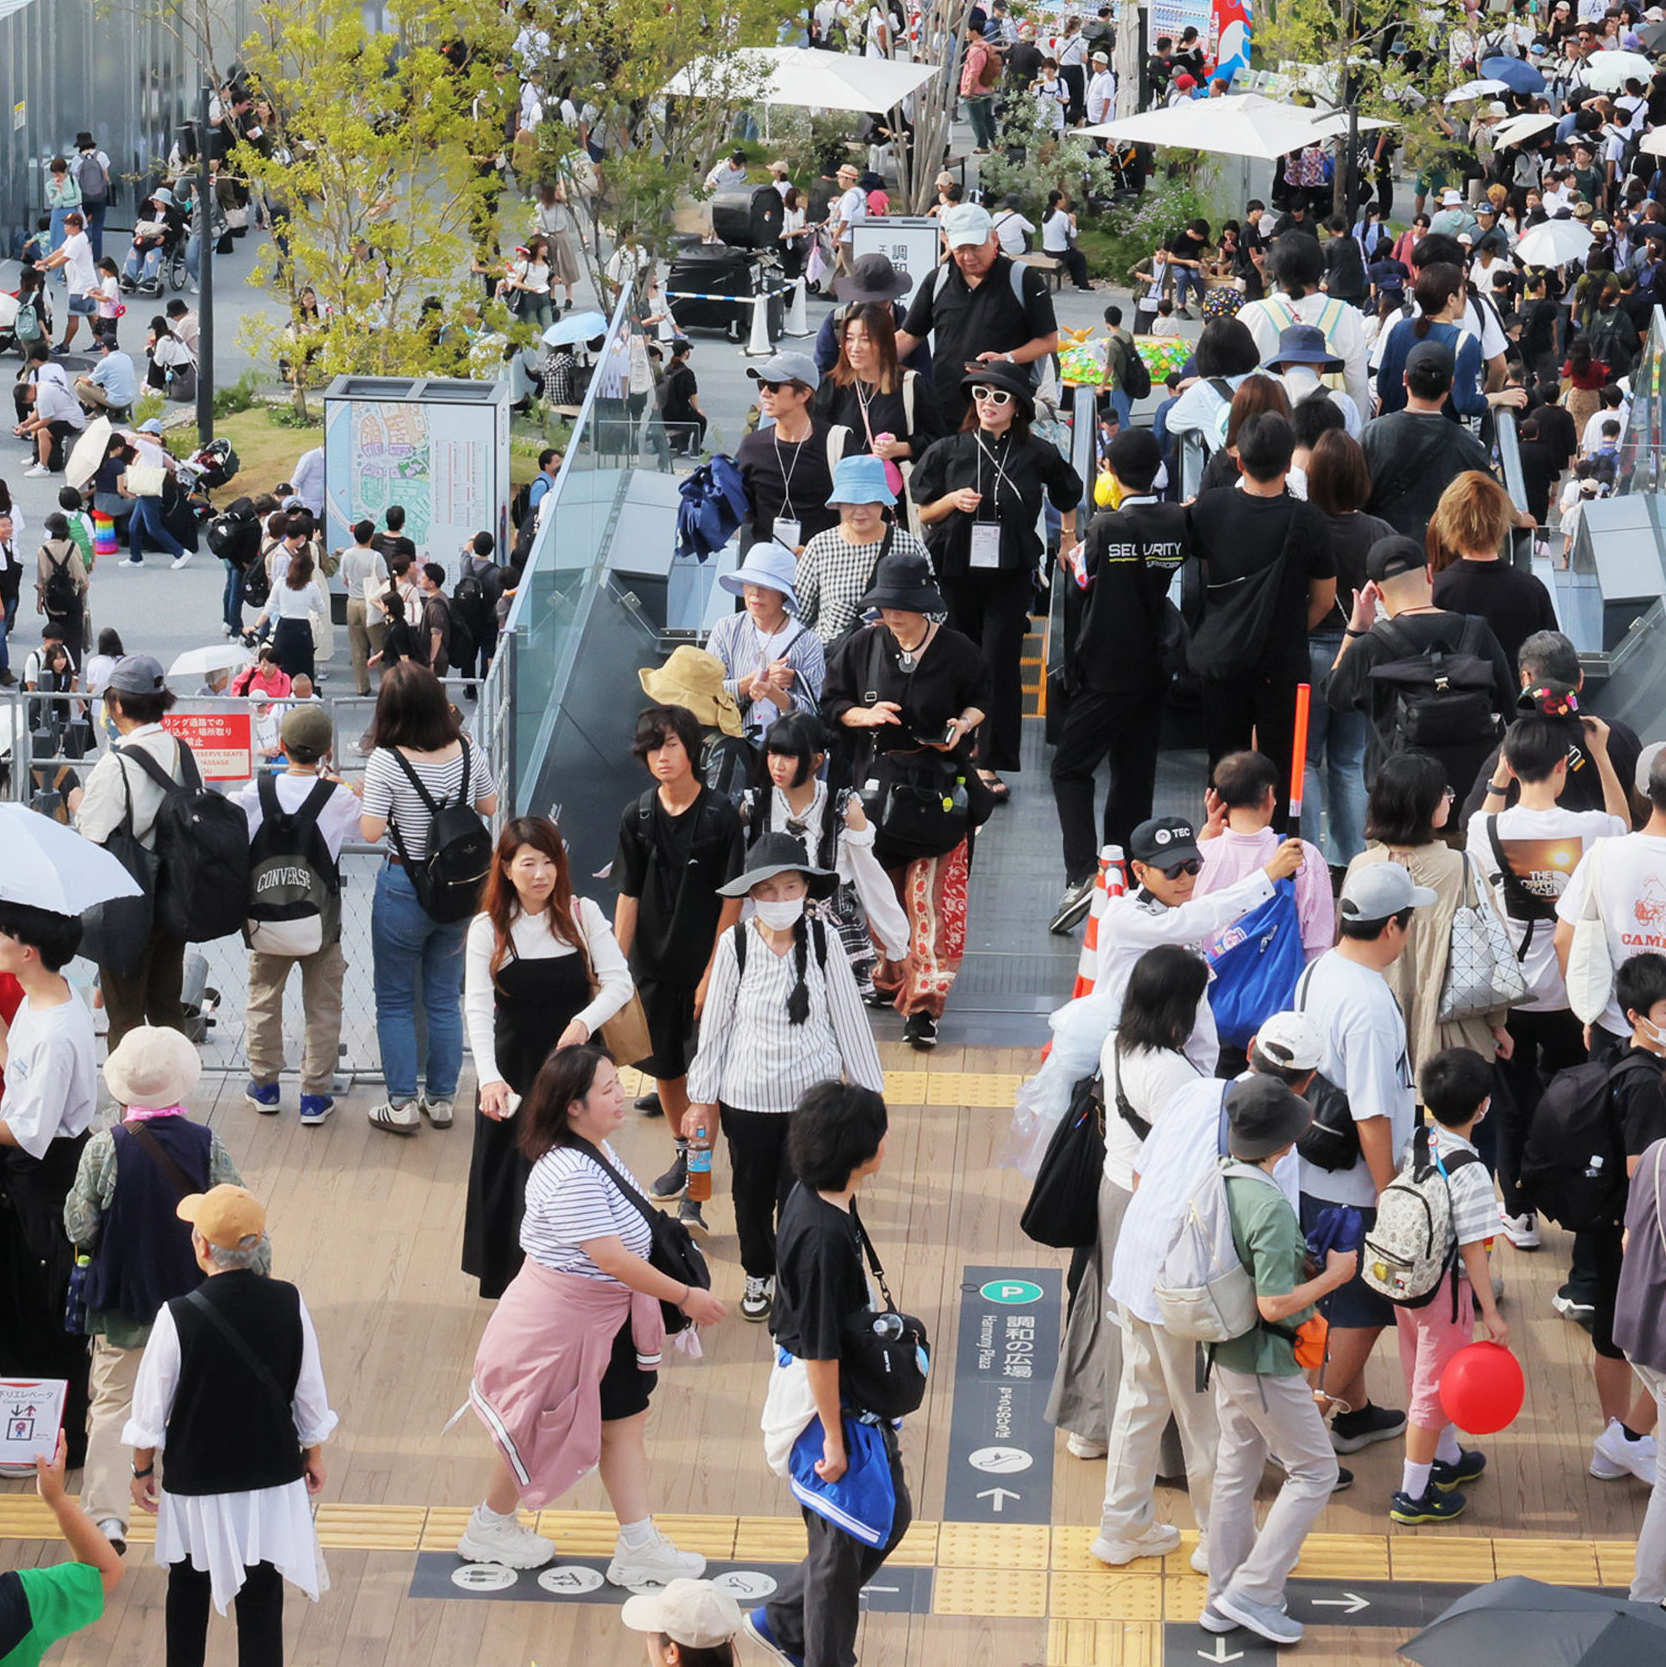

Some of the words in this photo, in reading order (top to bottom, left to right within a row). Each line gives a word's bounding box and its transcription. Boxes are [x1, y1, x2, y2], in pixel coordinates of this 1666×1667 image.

[1172, 827, 1191, 838] TEC
[257, 866, 312, 893] CONVERSE
[1001, 1286, 1024, 1298] P
[976, 1315, 998, 1348] Harmony
[1002, 1315, 1036, 1378] 調和の広場
[978, 1349, 996, 1370] Plaza
